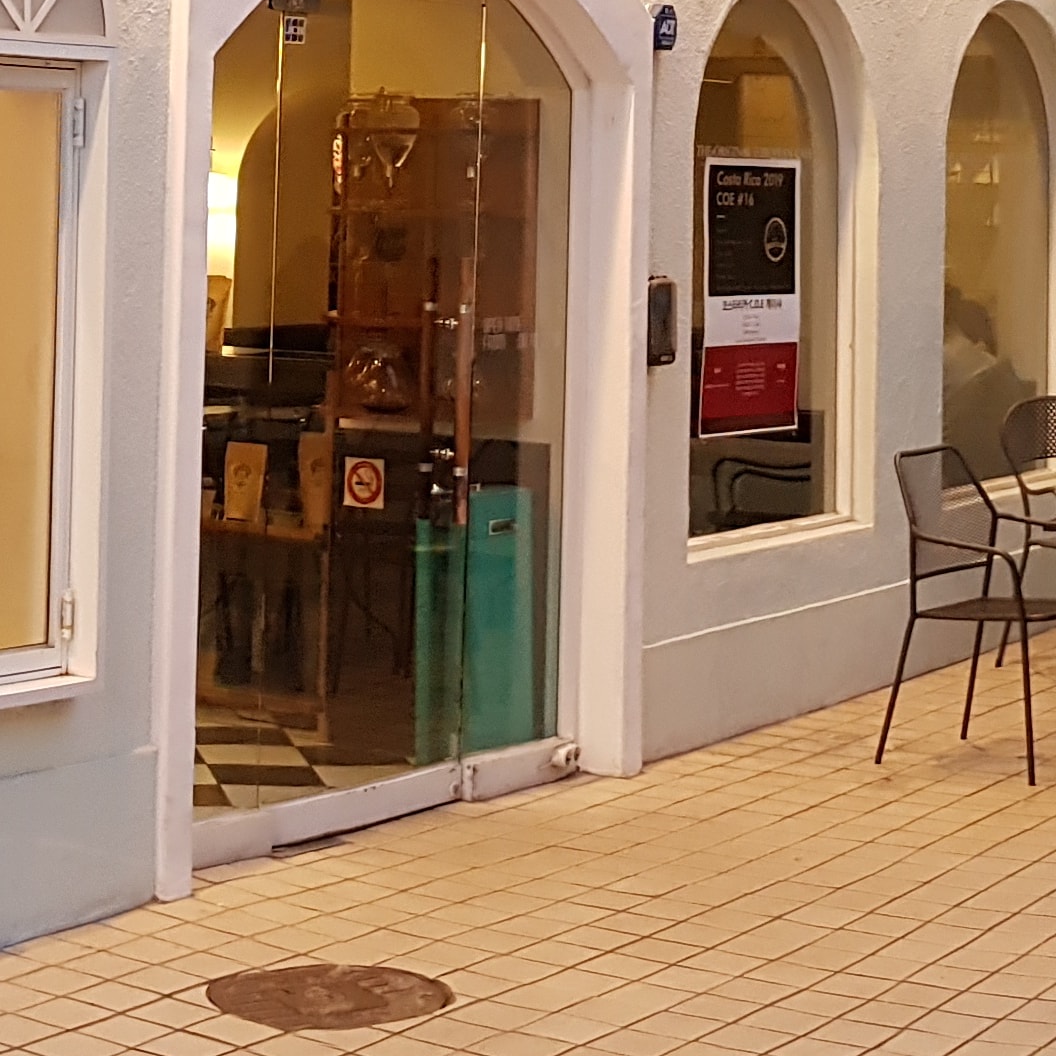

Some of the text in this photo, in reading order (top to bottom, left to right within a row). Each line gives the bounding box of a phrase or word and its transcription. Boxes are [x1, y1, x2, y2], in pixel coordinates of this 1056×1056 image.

[716, 170, 742, 186] Costa
[743, 171, 762, 187] Rica
[716, 191, 735, 206] COE
